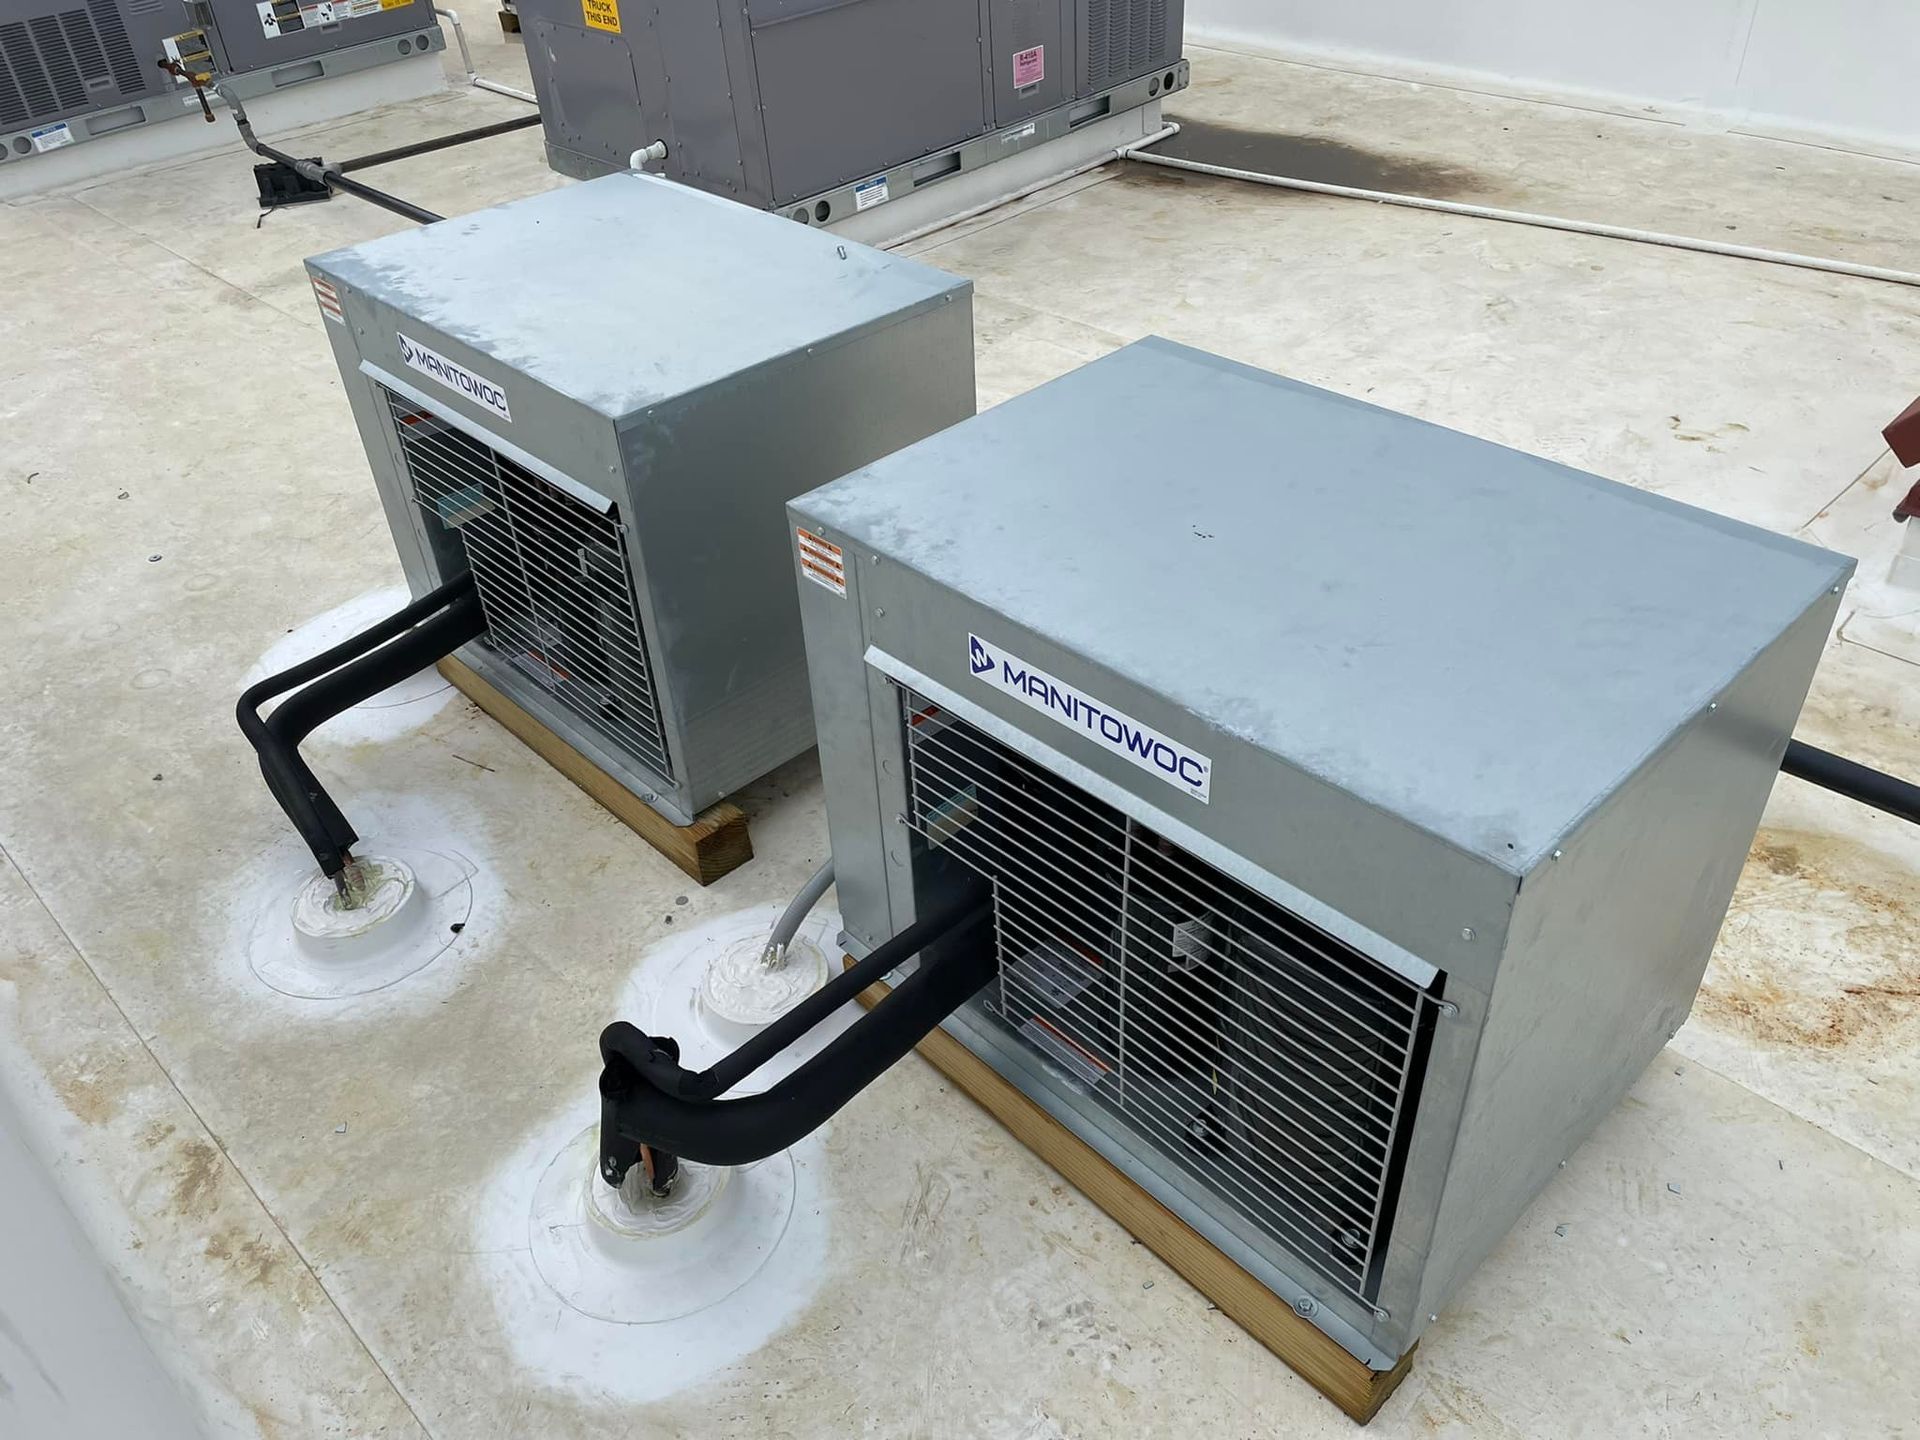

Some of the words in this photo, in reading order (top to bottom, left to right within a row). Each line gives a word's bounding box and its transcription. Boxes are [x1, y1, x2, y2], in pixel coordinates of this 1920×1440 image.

[586, 11, 602, 24] THIS
[603, 15, 618, 27] END
[587, 0, 612, 14] TRUCK
[415, 347, 506, 411] MANITOWOC
[1003, 660, 1203, 787] MANITOWOC
